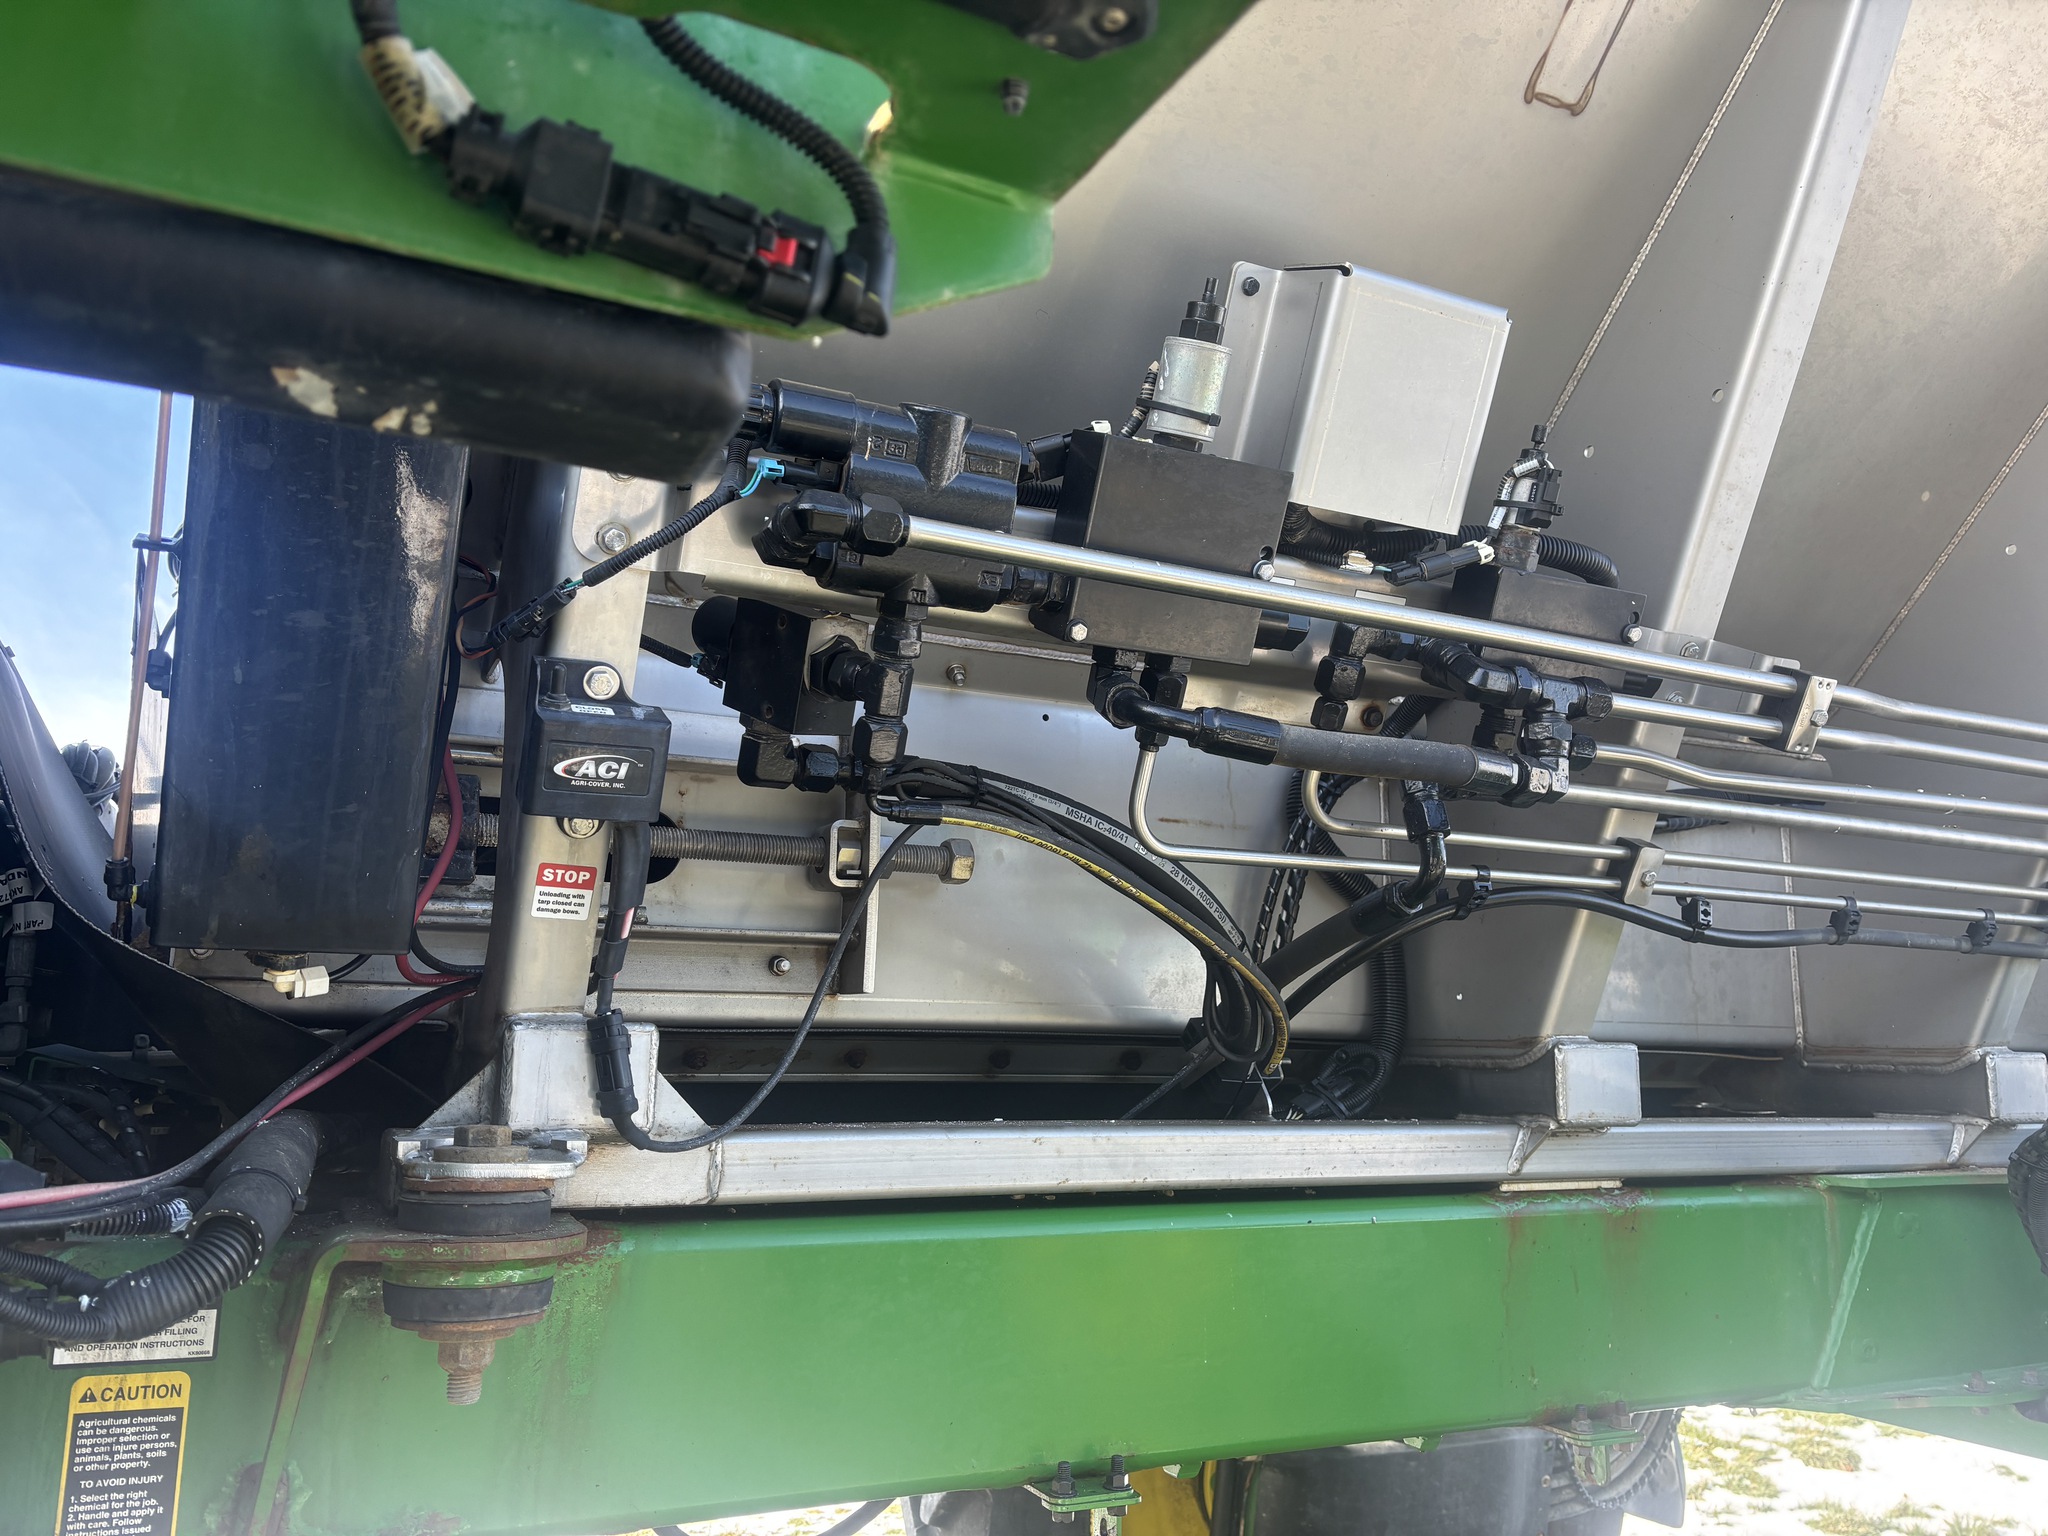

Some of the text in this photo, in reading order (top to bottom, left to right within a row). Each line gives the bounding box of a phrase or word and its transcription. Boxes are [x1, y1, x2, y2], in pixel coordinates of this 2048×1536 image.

[575, 760, 629, 779] ACI
[571, 780, 611, 788] AGRI-COVER,
[1065, 806, 1093, 826] MSHA
[542, 869, 590, 884] STOP
[539, 891, 570, 899] Unloading
[1170, 866, 1227, 925] 28 MPa (4000 PSI)
[537, 899, 550, 907] tarp
[551, 899, 572, 907] closed
[536, 906, 562, 915] damage
[187, 1315, 206, 1323] FOR
[87, 1342, 138, 1351] OPERATION
[140, 1339, 204, 1348] INSTRUCTIONS
[101, 1384, 182, 1402] CAUTION
[78, 1414, 176, 1428] Agricultural chemicals
[96, 1427, 107, 1435] be
[109, 1424, 158, 1435] dangerous.
[76, 1436, 117, 1448] Improper
[119, 1433, 158, 1442] selection
[112, 1443, 137, 1453] injure
[140, 1440, 177, 1451] persons,
[74, 1450, 167, 1463] animals, plants, soils
[73, 1460, 151, 1472] or other property.
[80, 1475, 163, 1488] TO AVOID INJURY
[80, 1494, 108, 1503] Select
[110, 1492, 125, 1500] the
[126, 1490, 147, 1500] right
[68, 1498, 158, 1513] chemical for the job.
[67, 1506, 163, 1522] 2. Handle and apply it
[67, 1517, 142, 1530] with care. Follow
[66, 1525, 151, 1536] instructions issued
